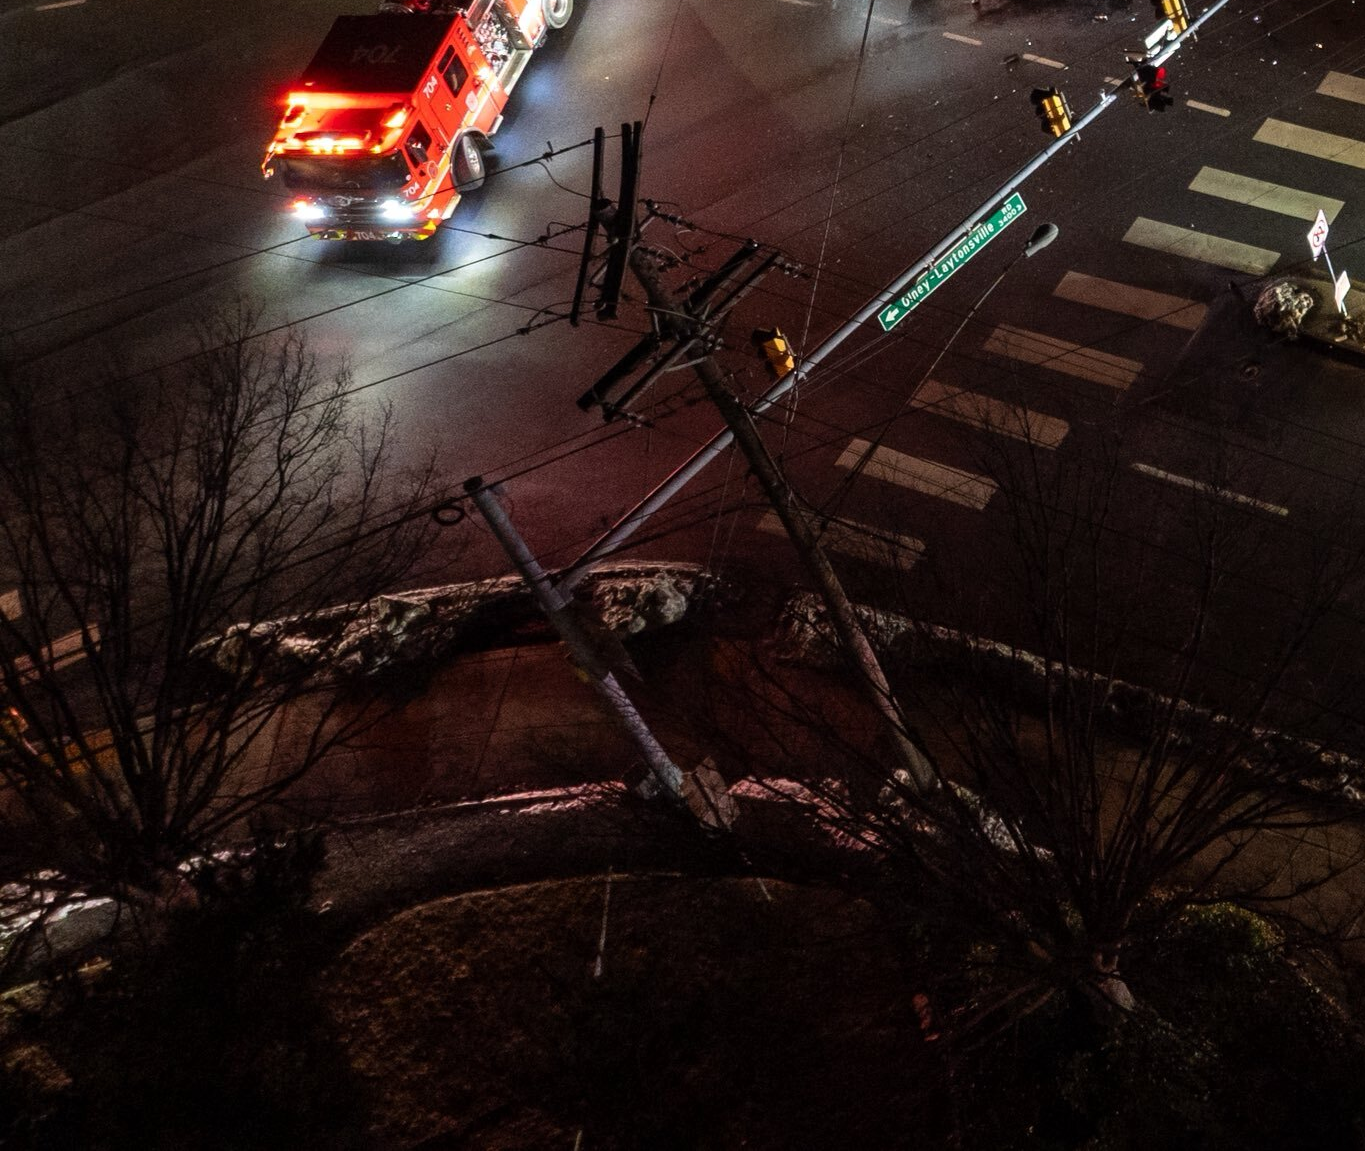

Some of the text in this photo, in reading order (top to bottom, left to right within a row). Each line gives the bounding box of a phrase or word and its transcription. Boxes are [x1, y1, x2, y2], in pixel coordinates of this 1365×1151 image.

[423, 76, 438, 98] 704
[403, 182, 420, 197] 704
[1000, 203, 1012, 216] RD
[356, 231, 376, 240] 704
